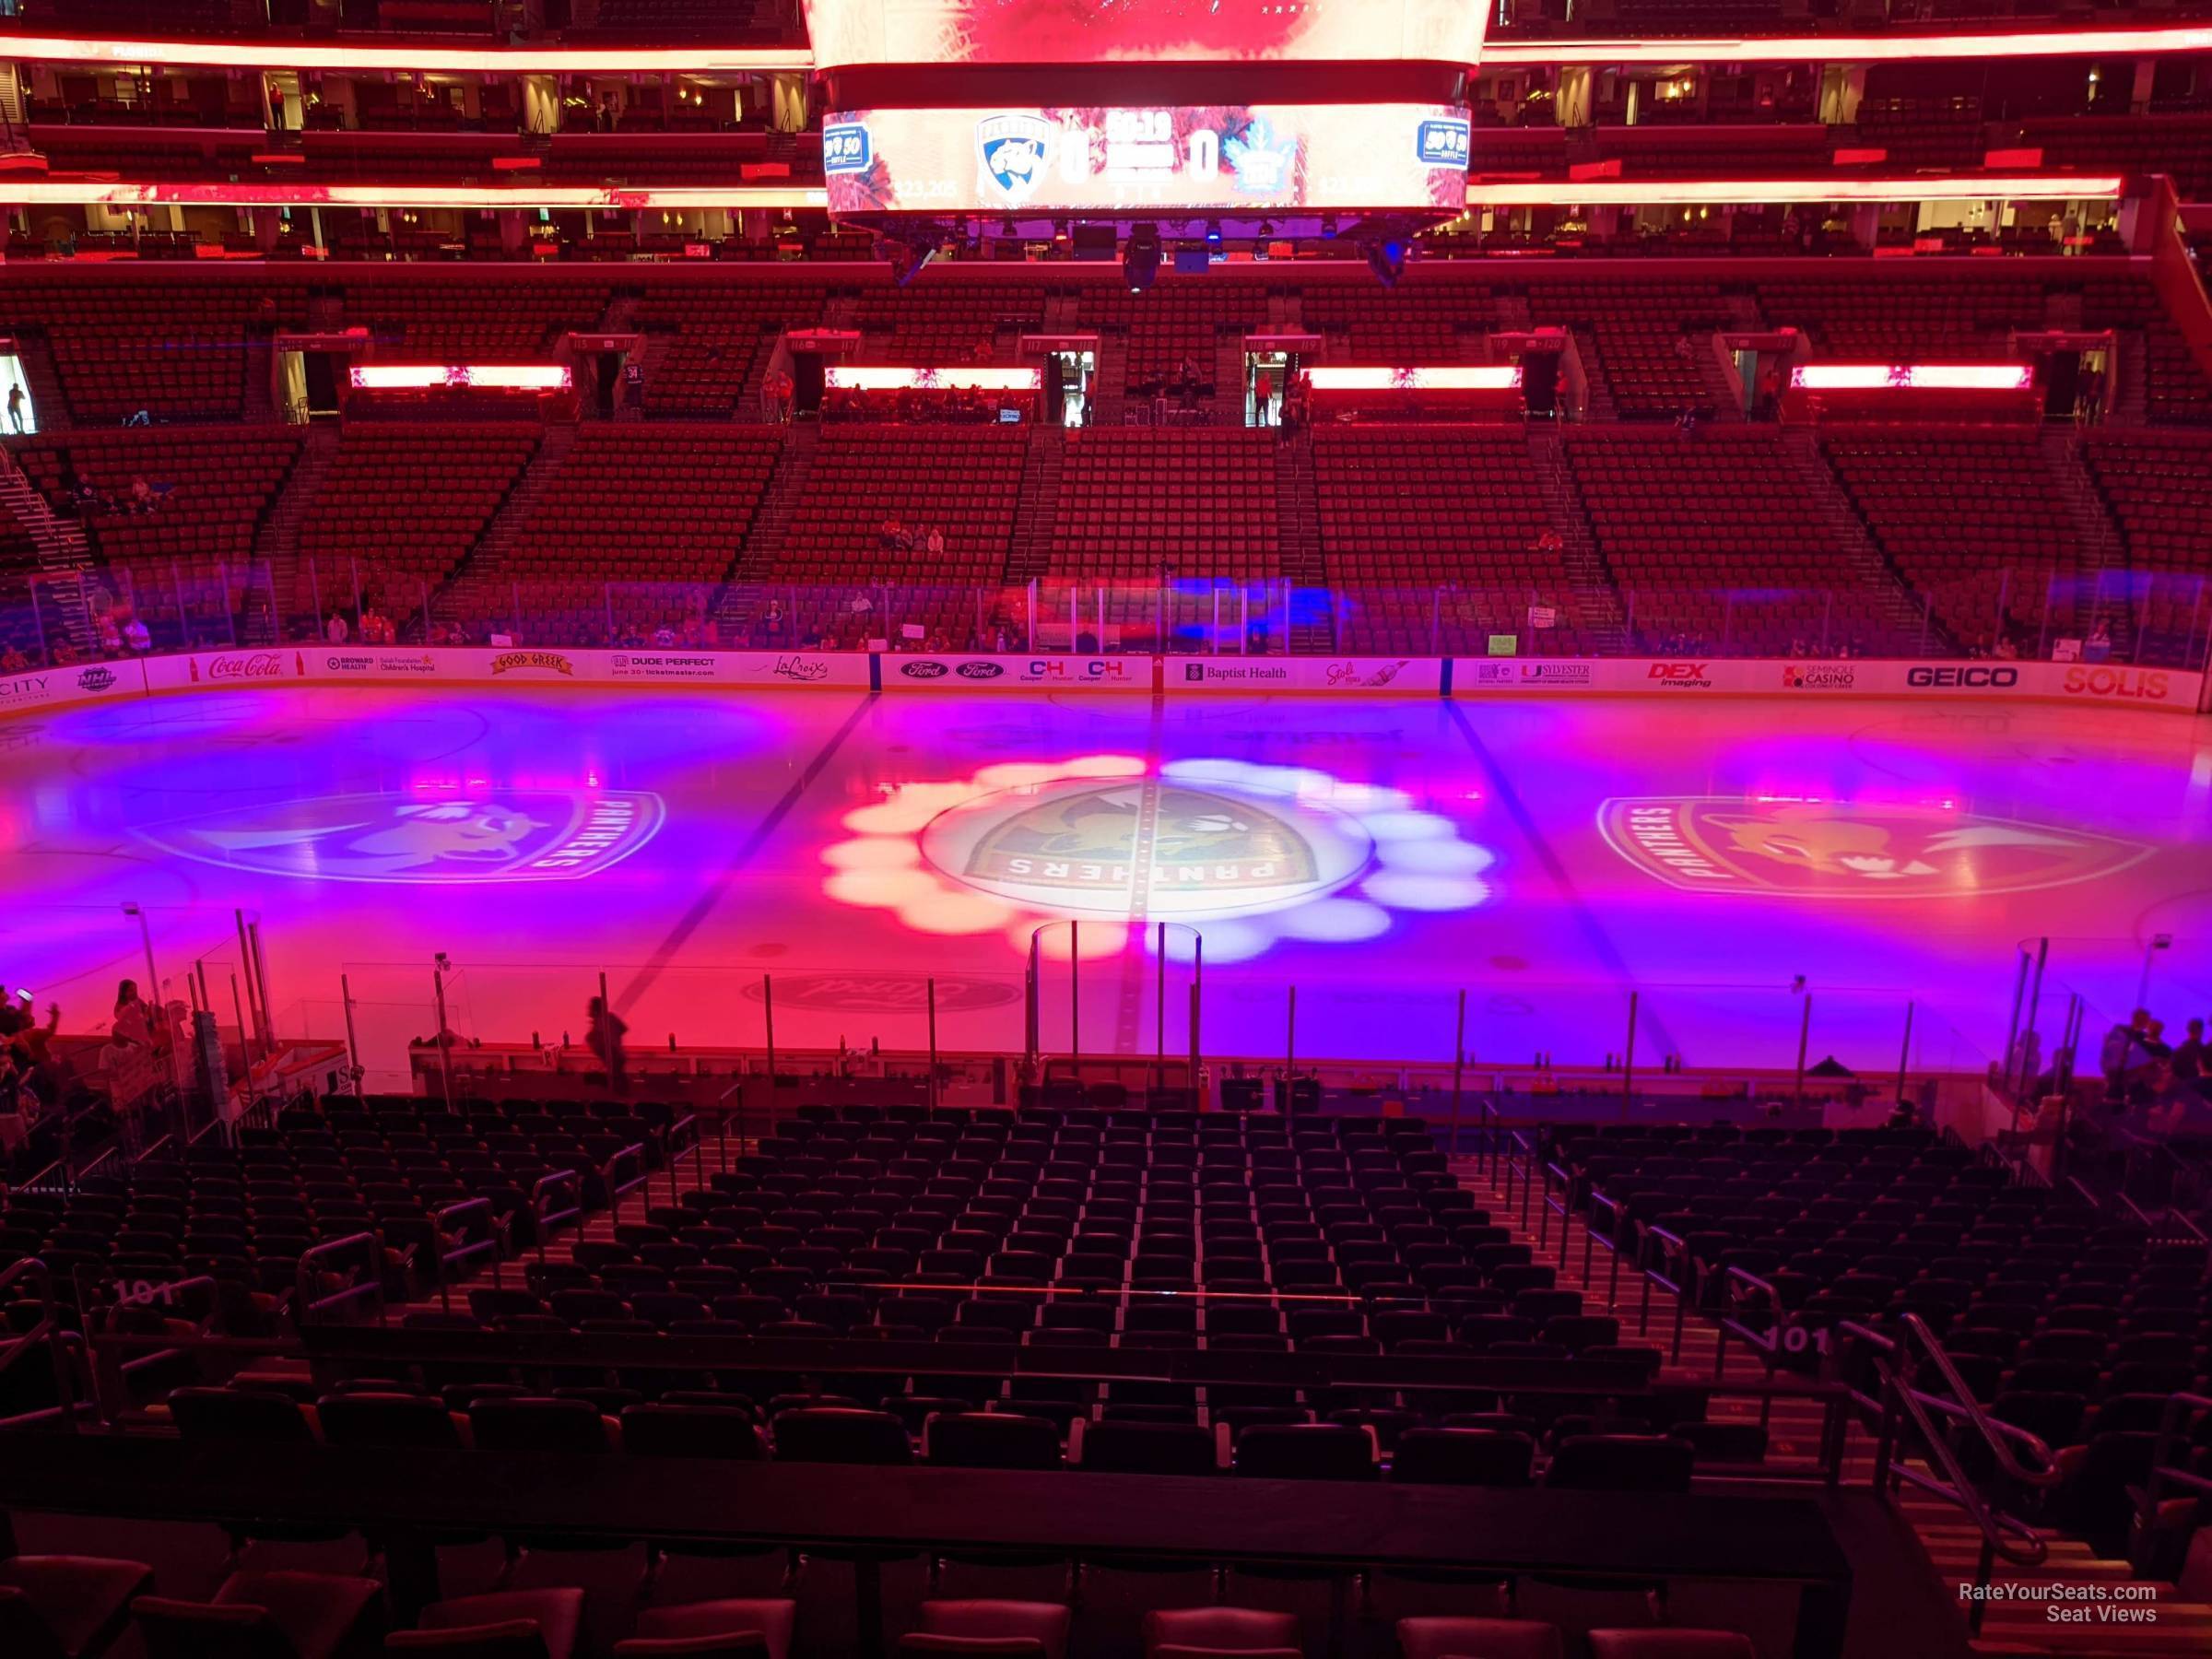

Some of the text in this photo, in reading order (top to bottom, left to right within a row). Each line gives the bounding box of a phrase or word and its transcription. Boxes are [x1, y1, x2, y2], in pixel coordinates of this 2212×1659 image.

[1190, 129, 1218, 183] 0
[381, 663, 436, 674] Children's Hospital
[500, 653, 563, 669] GOOD GREEK
[631, 657, 664, 665] DUDE
[665, 657, 715, 666] PERFECT
[1030, 661, 1064, 676] CH
[1088, 661, 1123, 676] CH
[645, 668, 714, 677] ticketmaster.com
[908, 662, 941, 677] Ford
[963, 663, 996, 677] Ford
[1207, 666, 1287, 681] Baptist Health
[1326, 661, 1354, 686] Stoli
[1542, 664, 1590, 675] SYLVESTER
[1647, 663, 1710, 679] DEX
[1806, 665, 1855, 674] SEMINOLE
[1907, 666, 2018, 688] GEICO
[76, 671, 117, 687] NHL
[1020, 675, 1044, 683] Cooper
[1078, 675, 1102, 683] Cooper
[1660, 677, 1712, 688] imaging
[1806, 674, 1854, 684] CASINO
[2063, 666, 2169, 700] SOLIS
[0, 677, 50, 697] CITY
[535, 799, 634, 870] PANTHERS
[1630, 806, 1732, 879] PANTHERS
[112, 1278, 174, 1306] 101
[1762, 1325, 1830, 1353] 101
